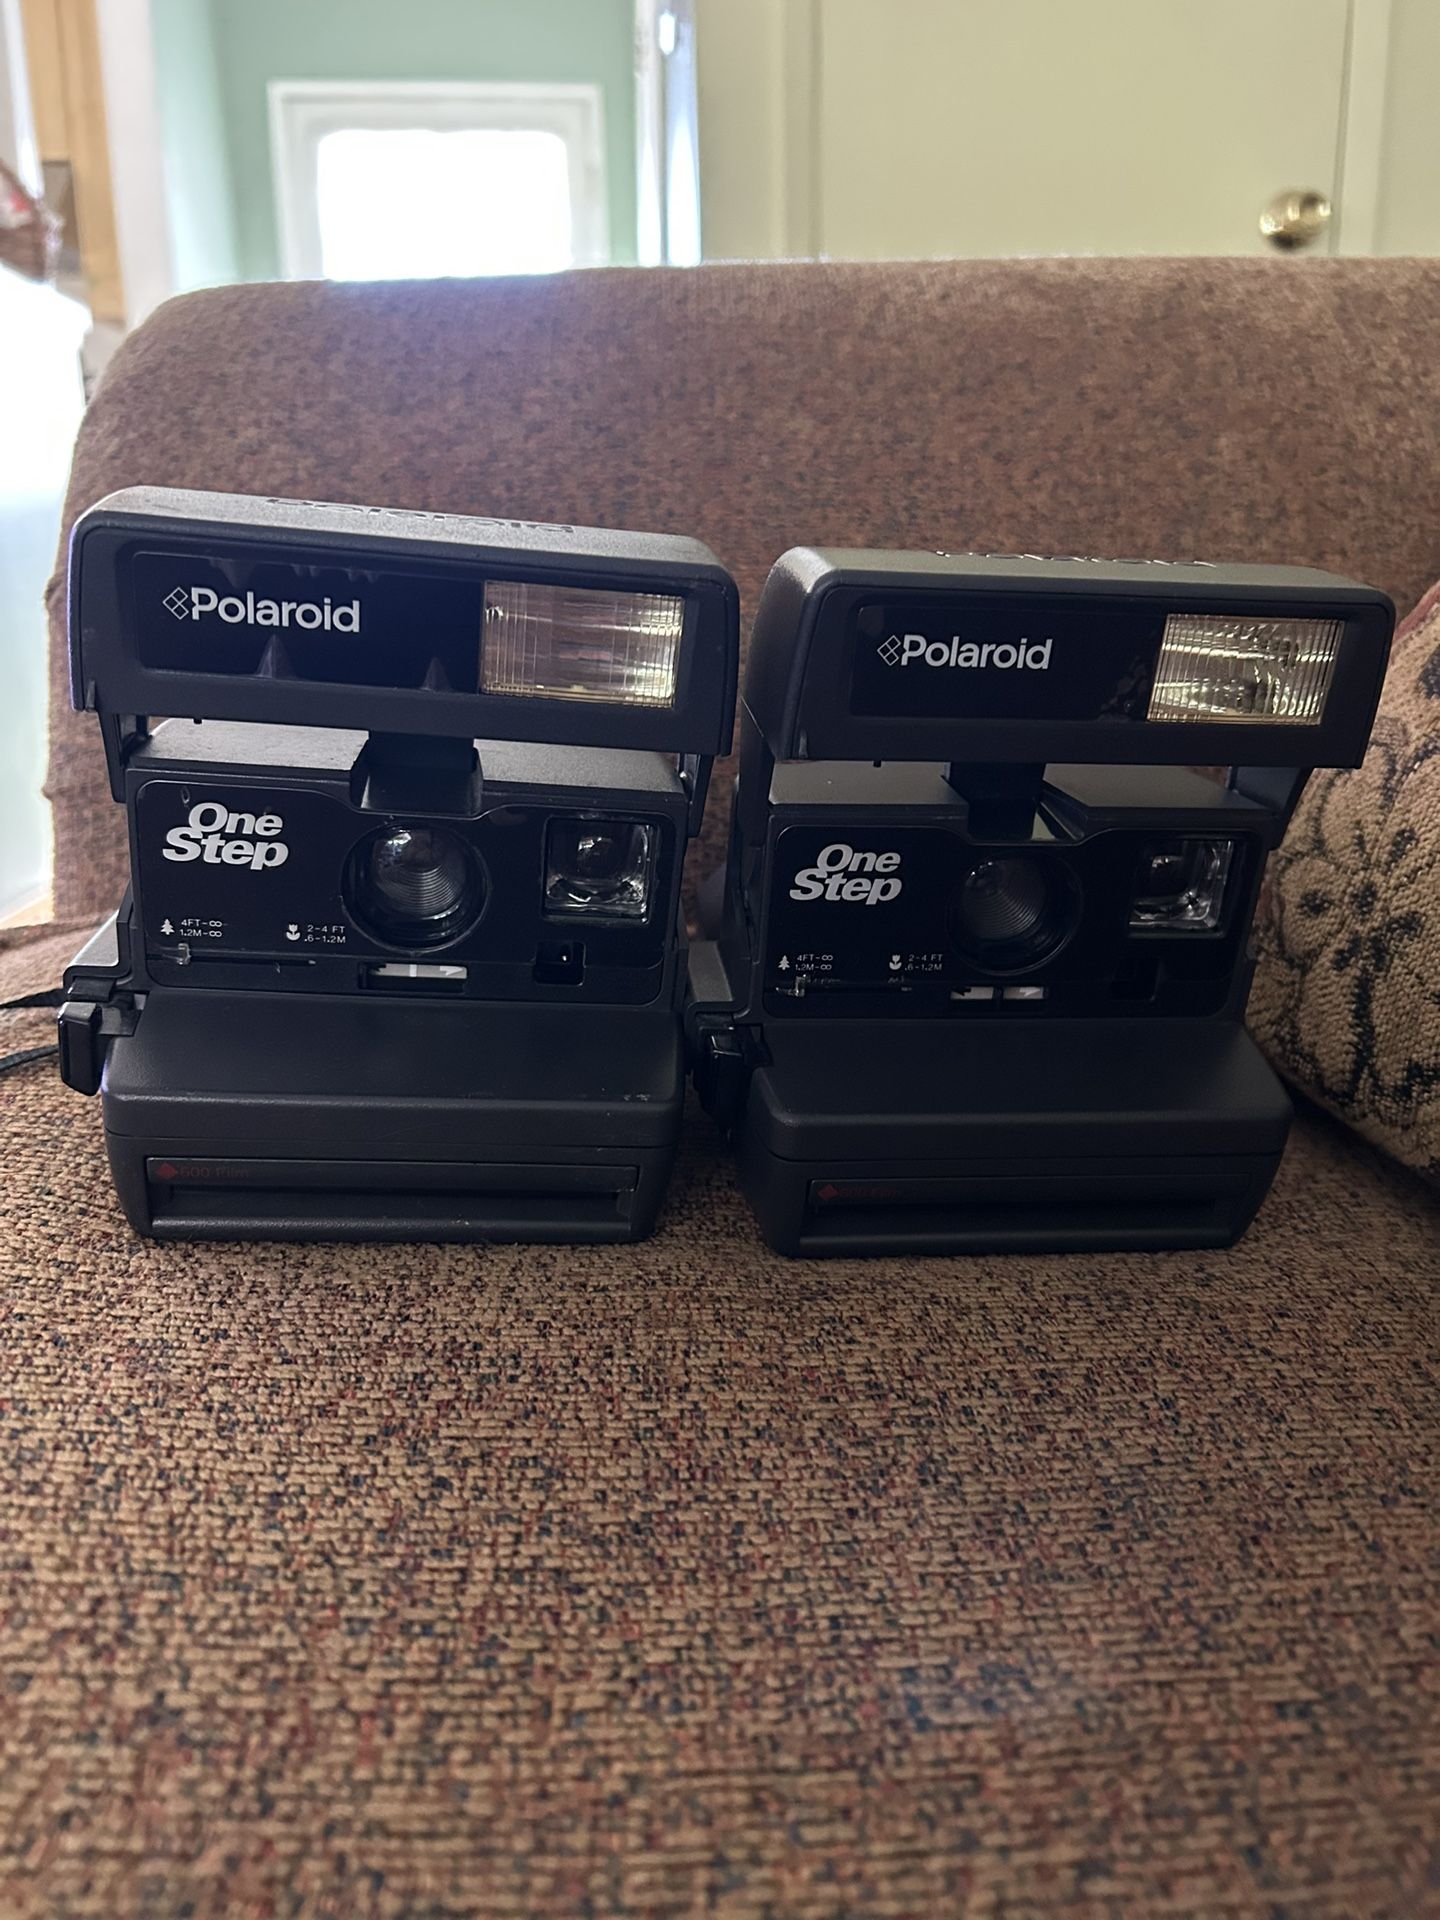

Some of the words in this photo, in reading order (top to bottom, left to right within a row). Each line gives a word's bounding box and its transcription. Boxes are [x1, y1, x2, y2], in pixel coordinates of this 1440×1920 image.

[190, 586, 361, 633] Polaroid
[900, 634, 1054, 670] Polaroid
[188, 801, 284, 837] One
[162, 826, 289, 871] Step
[816, 843, 902, 873] One
[789, 867, 903, 906] Step
[331, 925, 346, 934] FT
[930, 953, 944, 962] FT
